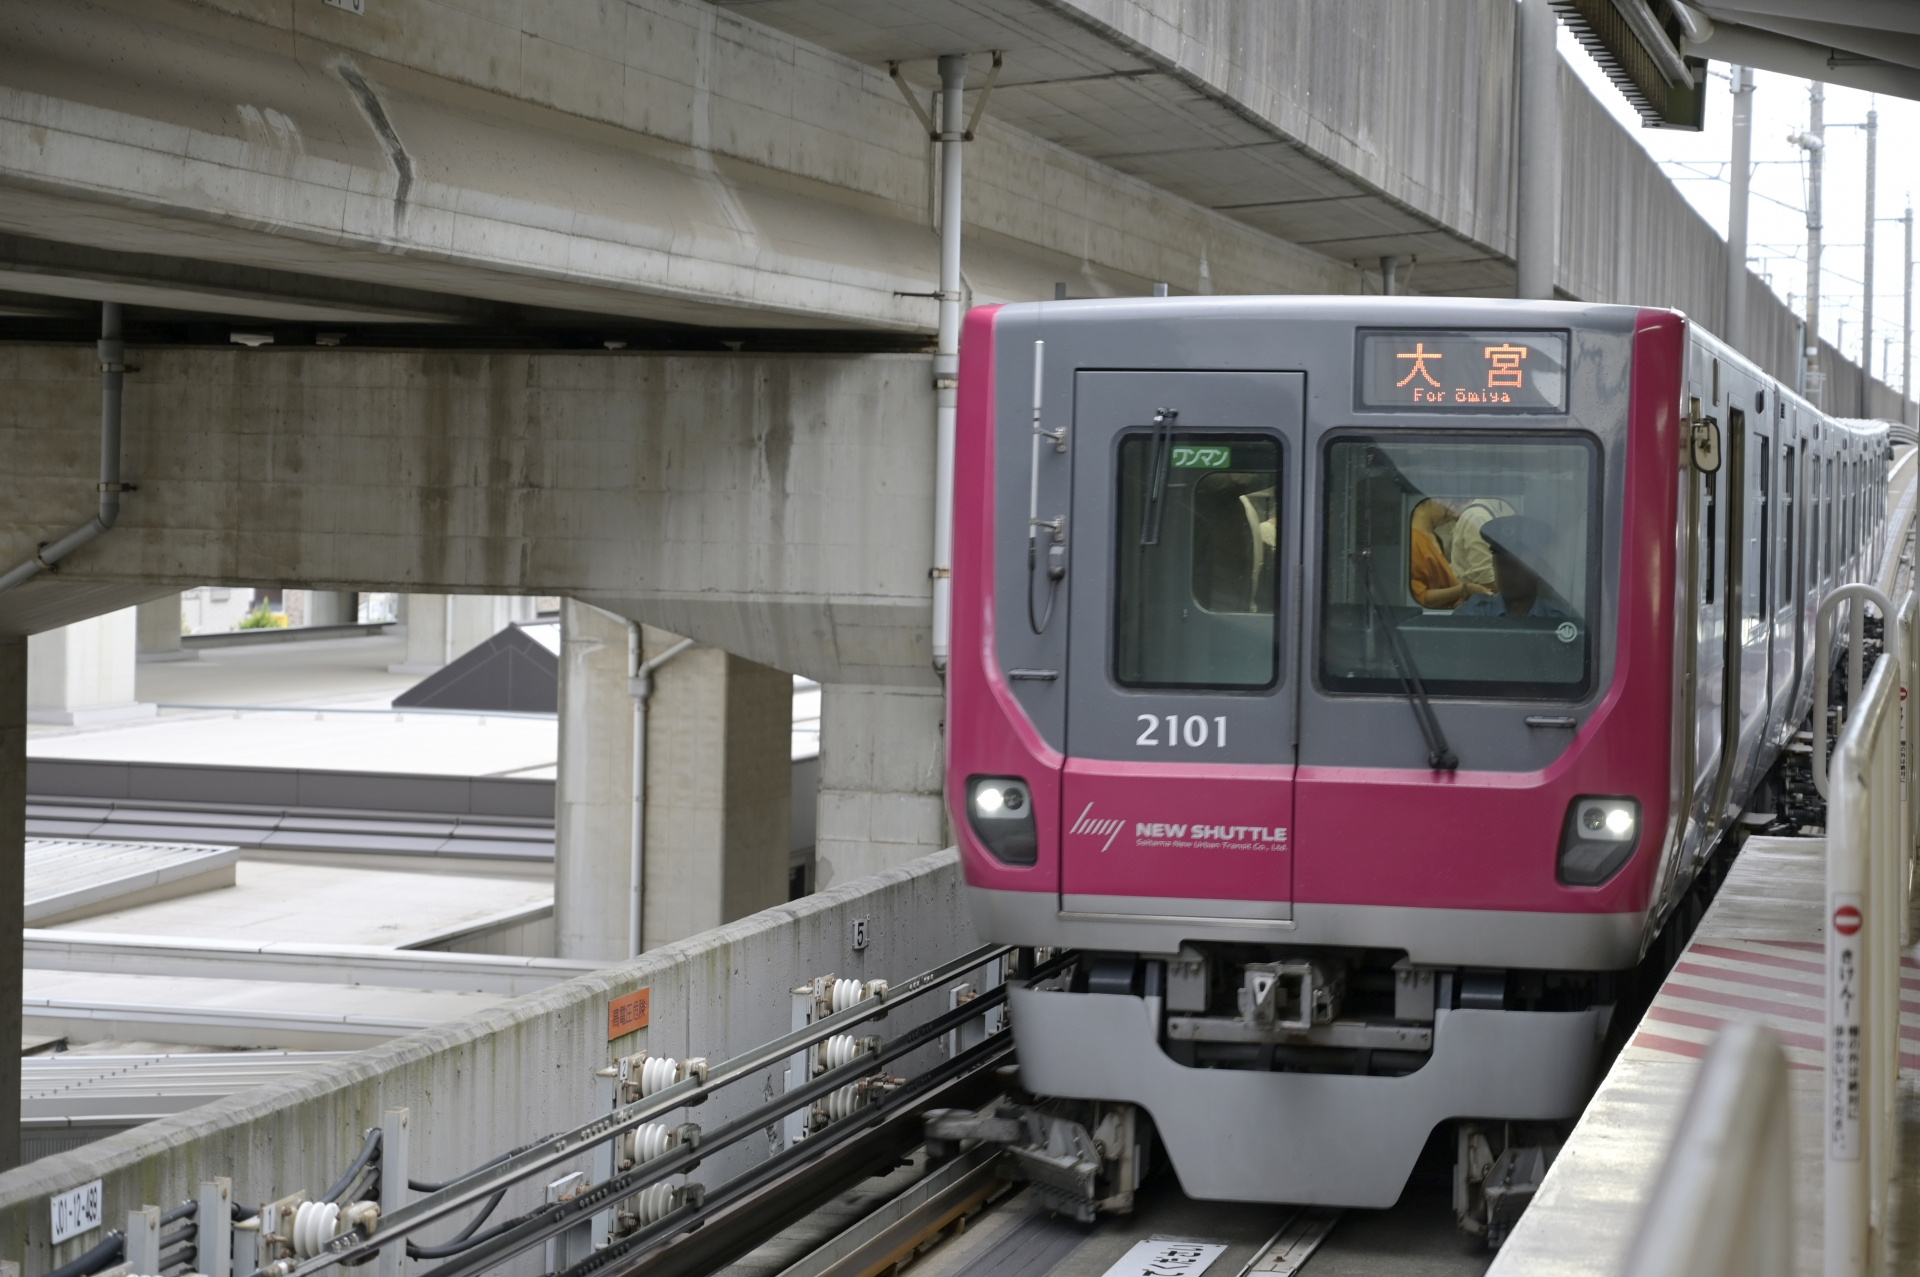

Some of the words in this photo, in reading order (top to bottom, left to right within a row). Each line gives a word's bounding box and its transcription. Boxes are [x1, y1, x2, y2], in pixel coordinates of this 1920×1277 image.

[1397, 343, 1528, 388] 大宮
[1414, 388, 1446, 402] For
[1173, 448, 1229, 467] ワンマン
[1135, 713, 1227, 748] 2101
[1135, 822, 1188, 838] NEW
[1190, 824, 1288, 843] SHUTTLE
[1135, 838, 1172, 848] Saitama
[1173, 840, 1193, 849] New
[1194, 841, 1221, 850] Urban
[1221, 841, 1251, 851] Transit
[857, 921, 864, 947] 5
[611, 999, 647, 1029] 高電圧危険
[622, 1059, 627, 1078] 2
